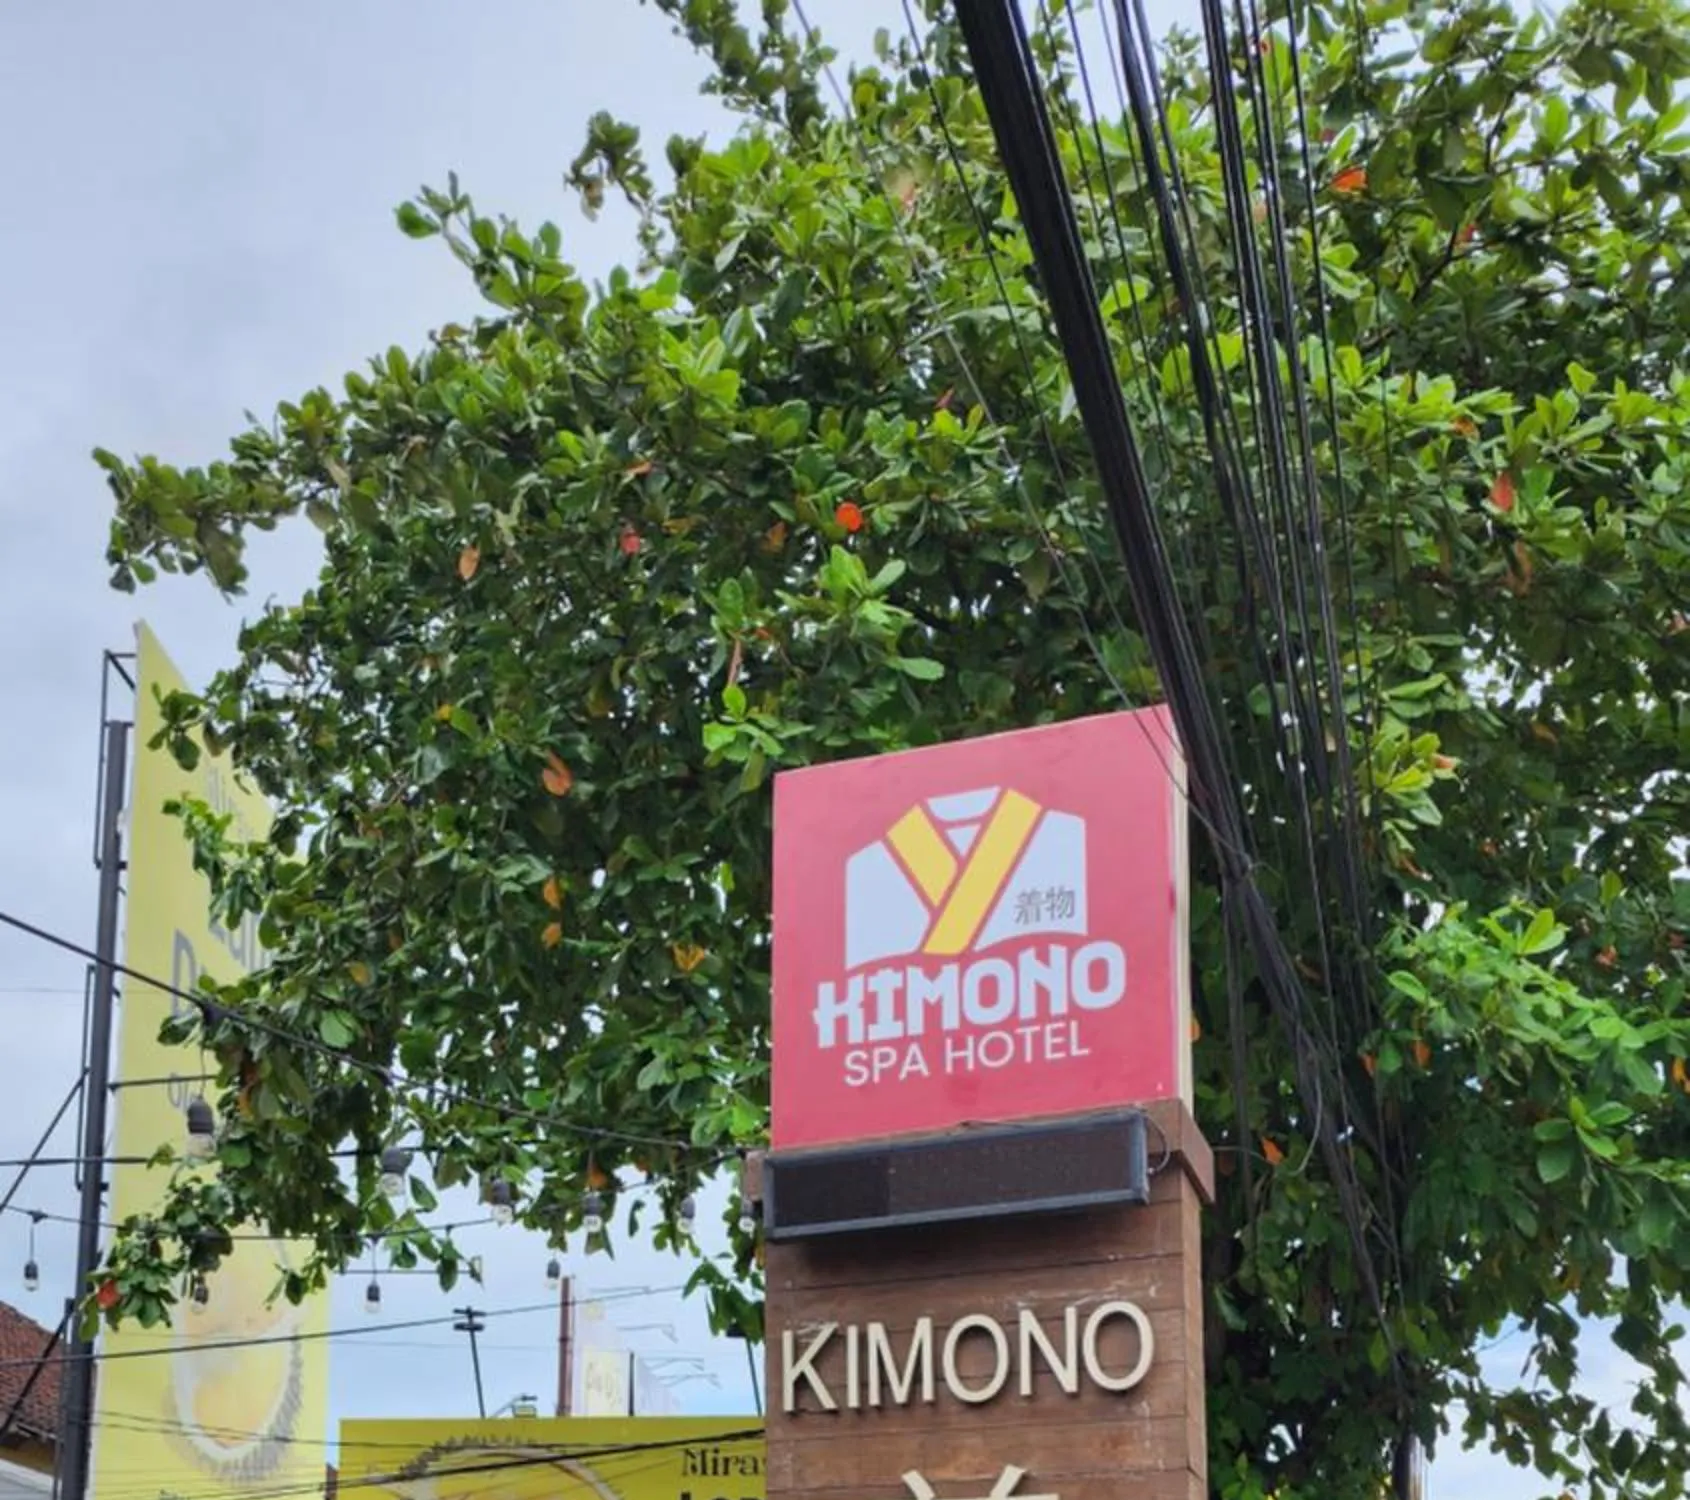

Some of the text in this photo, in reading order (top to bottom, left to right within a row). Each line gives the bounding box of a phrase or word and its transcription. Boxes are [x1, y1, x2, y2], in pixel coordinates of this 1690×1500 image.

[1014, 885, 1076, 925] 着物
[812, 940, 1128, 1049] KIMONO
[844, 1020, 1091, 1087] SPA HOTEL
[782, 1301, 1155, 1413] KIMONO
[682, 1447, 767, 1477] Mira
